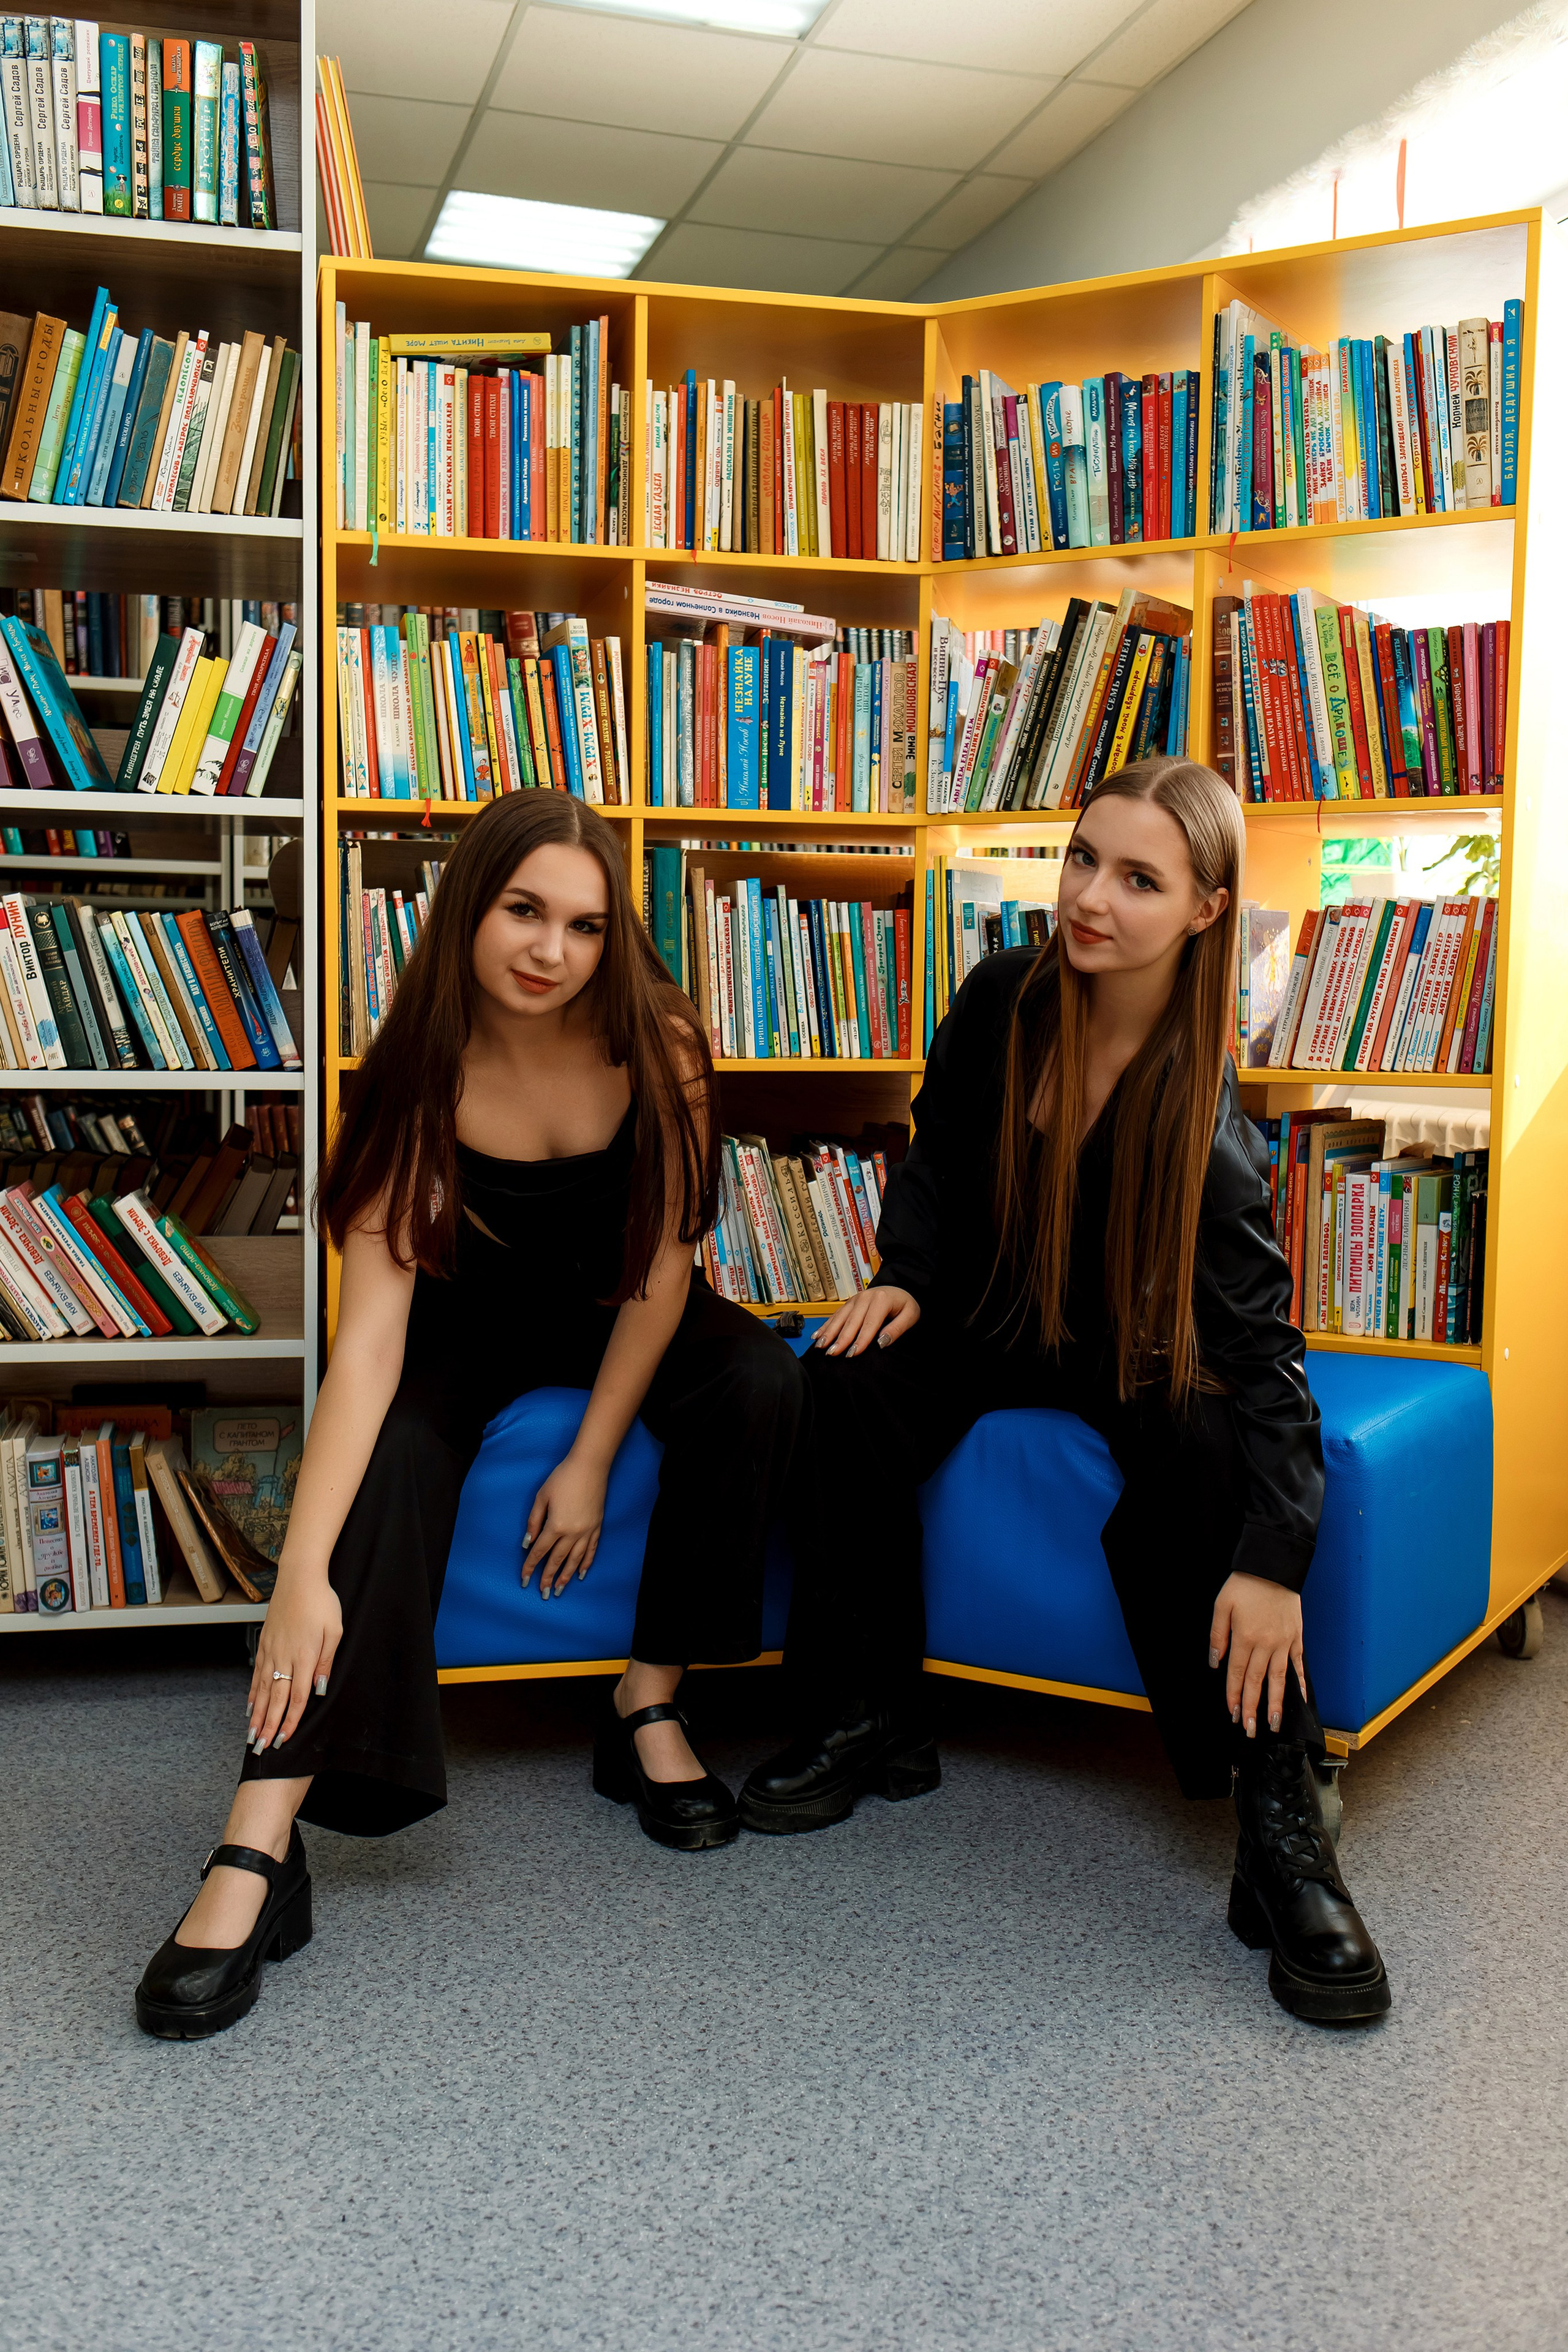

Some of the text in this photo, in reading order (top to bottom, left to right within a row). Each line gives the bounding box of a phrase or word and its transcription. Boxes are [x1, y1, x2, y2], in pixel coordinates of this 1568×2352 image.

[11, 64, 24, 126] Сергей Садов
[34, 67, 47, 129] Сергей Садов
[60, 67, 71, 129] Сергей Садов
[248, 127, 258, 151] ДЕЛО
[176, 351, 192, 403] НЕДОПЁСОК
[1447, 334, 1463, 428] Корней ЧУКОВСКИЙ
[1505, 364, 1516, 422] ДЕДУШКА
[166, 460, 180, 502] КУРОЛЕСОВ
[177, 422, 188, 453] МАТРОС
[184, 358, 202, 420] ПОДКЛЮЧАЮТСЯ
[649, 597, 674, 606] городе
[676, 601, 716, 614] Солнечном
[725, 608, 760, 620] Незнайка
[733, 649, 744, 712] НЕЗНАЙКА
[745, 689, 753, 705] НА
[1106, 638, 1131, 710] СЕМЬ ОГНЕЙ
[135, 720, 147, 737] ПУТЬ
[141, 700, 153, 719] ЗМЕЯ
[147, 689, 157, 699] НА
[579, 692, 597, 769] ХРУМ-ХРУМ
[893, 673, 905, 742] МИХАЛКОВ
[905, 662, 917, 760] Эмма МОШКОВСКАЯ
[1084, 720, 1109, 790] Борис Житков
[1437, 698, 1450, 781] ЭВКАЛИПТОВЫЙ ПРИШЕЛЕЦ
[6, 901, 37, 980] Виктор ЛУНИН
[59, 980, 73, 1012] ГАЙДАР
[217, 946, 241, 998] ХРАНИТЕЛИ
[1311, 1024, 1322, 1053] СТРАНЕ
[1318, 960, 1338, 1021] НЕВЫУЧЕННЫХ
[1333, 927, 1346, 958] УРОКОВ
[1358, 921, 1400, 1064] ВЕЧЕРА НА ХУТОРЕ БЛИЗ ДИКАНЬКИ
[1419, 932, 1444, 1014] МЯГКИЙ ХАРАКТЕР
[750, 1174, 766, 1218] КУРОЛЕСОВА
[767, 1242, 784, 1295] ПРИКЛЮЧЕНИЯ
[1349, 1183, 1365, 1293] ПИТОМЦЫ ЗООПАРКА
[44, 1270, 77, 1315] КИР БУЛЫЧЕВ
[173, 1271, 207, 1314] КИР БУЛЫЧЕВ
